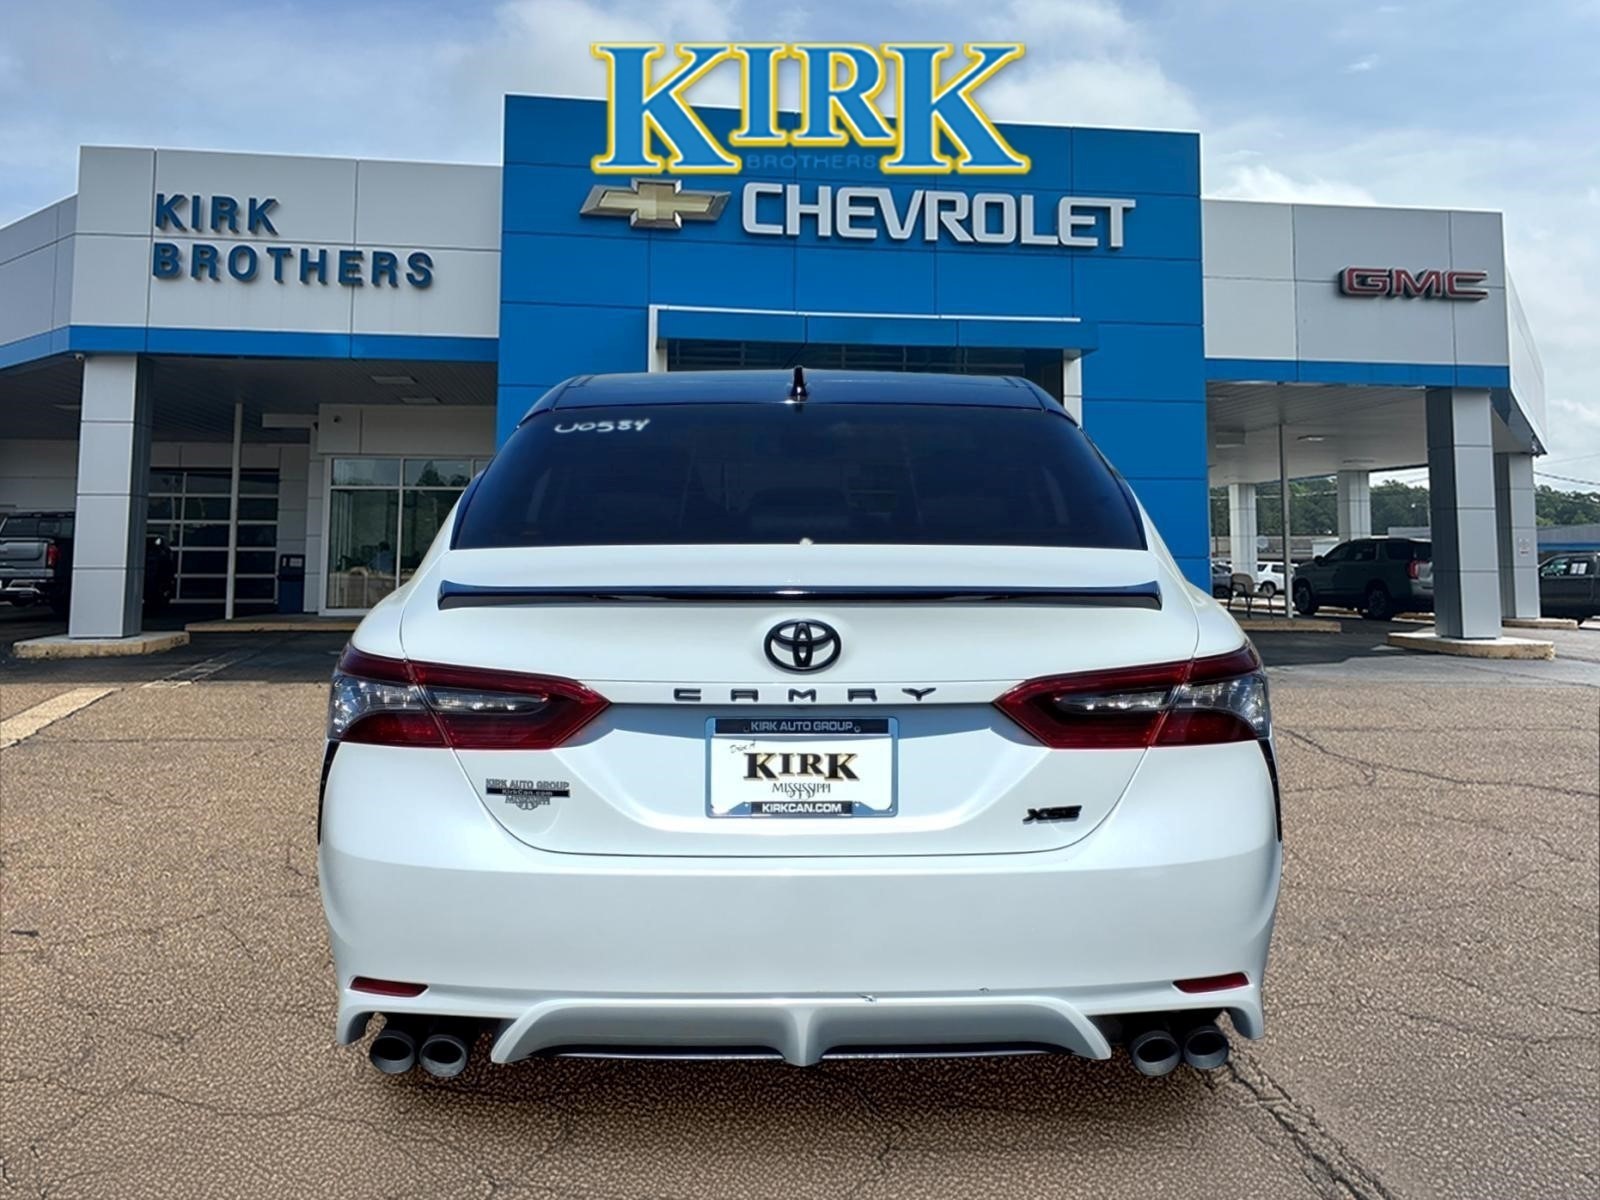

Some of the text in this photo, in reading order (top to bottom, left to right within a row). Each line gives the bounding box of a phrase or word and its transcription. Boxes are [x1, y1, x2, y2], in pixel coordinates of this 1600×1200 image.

[155, 193, 280, 236] KIRK
[742, 181, 1137, 249] CHEVROLET
[152, 242, 434, 289] BROTHERS
[1338, 267, 1489, 300] GMC
[673, 687, 937, 702] CAMRY
[750, 721, 853, 731] KIRK AUTO GROUP
[743, 752, 860, 781] KIRK
[486, 778, 570, 790] KIRK AUTO GROUP
[762, 802, 842, 813] KIRKCAN.COM
